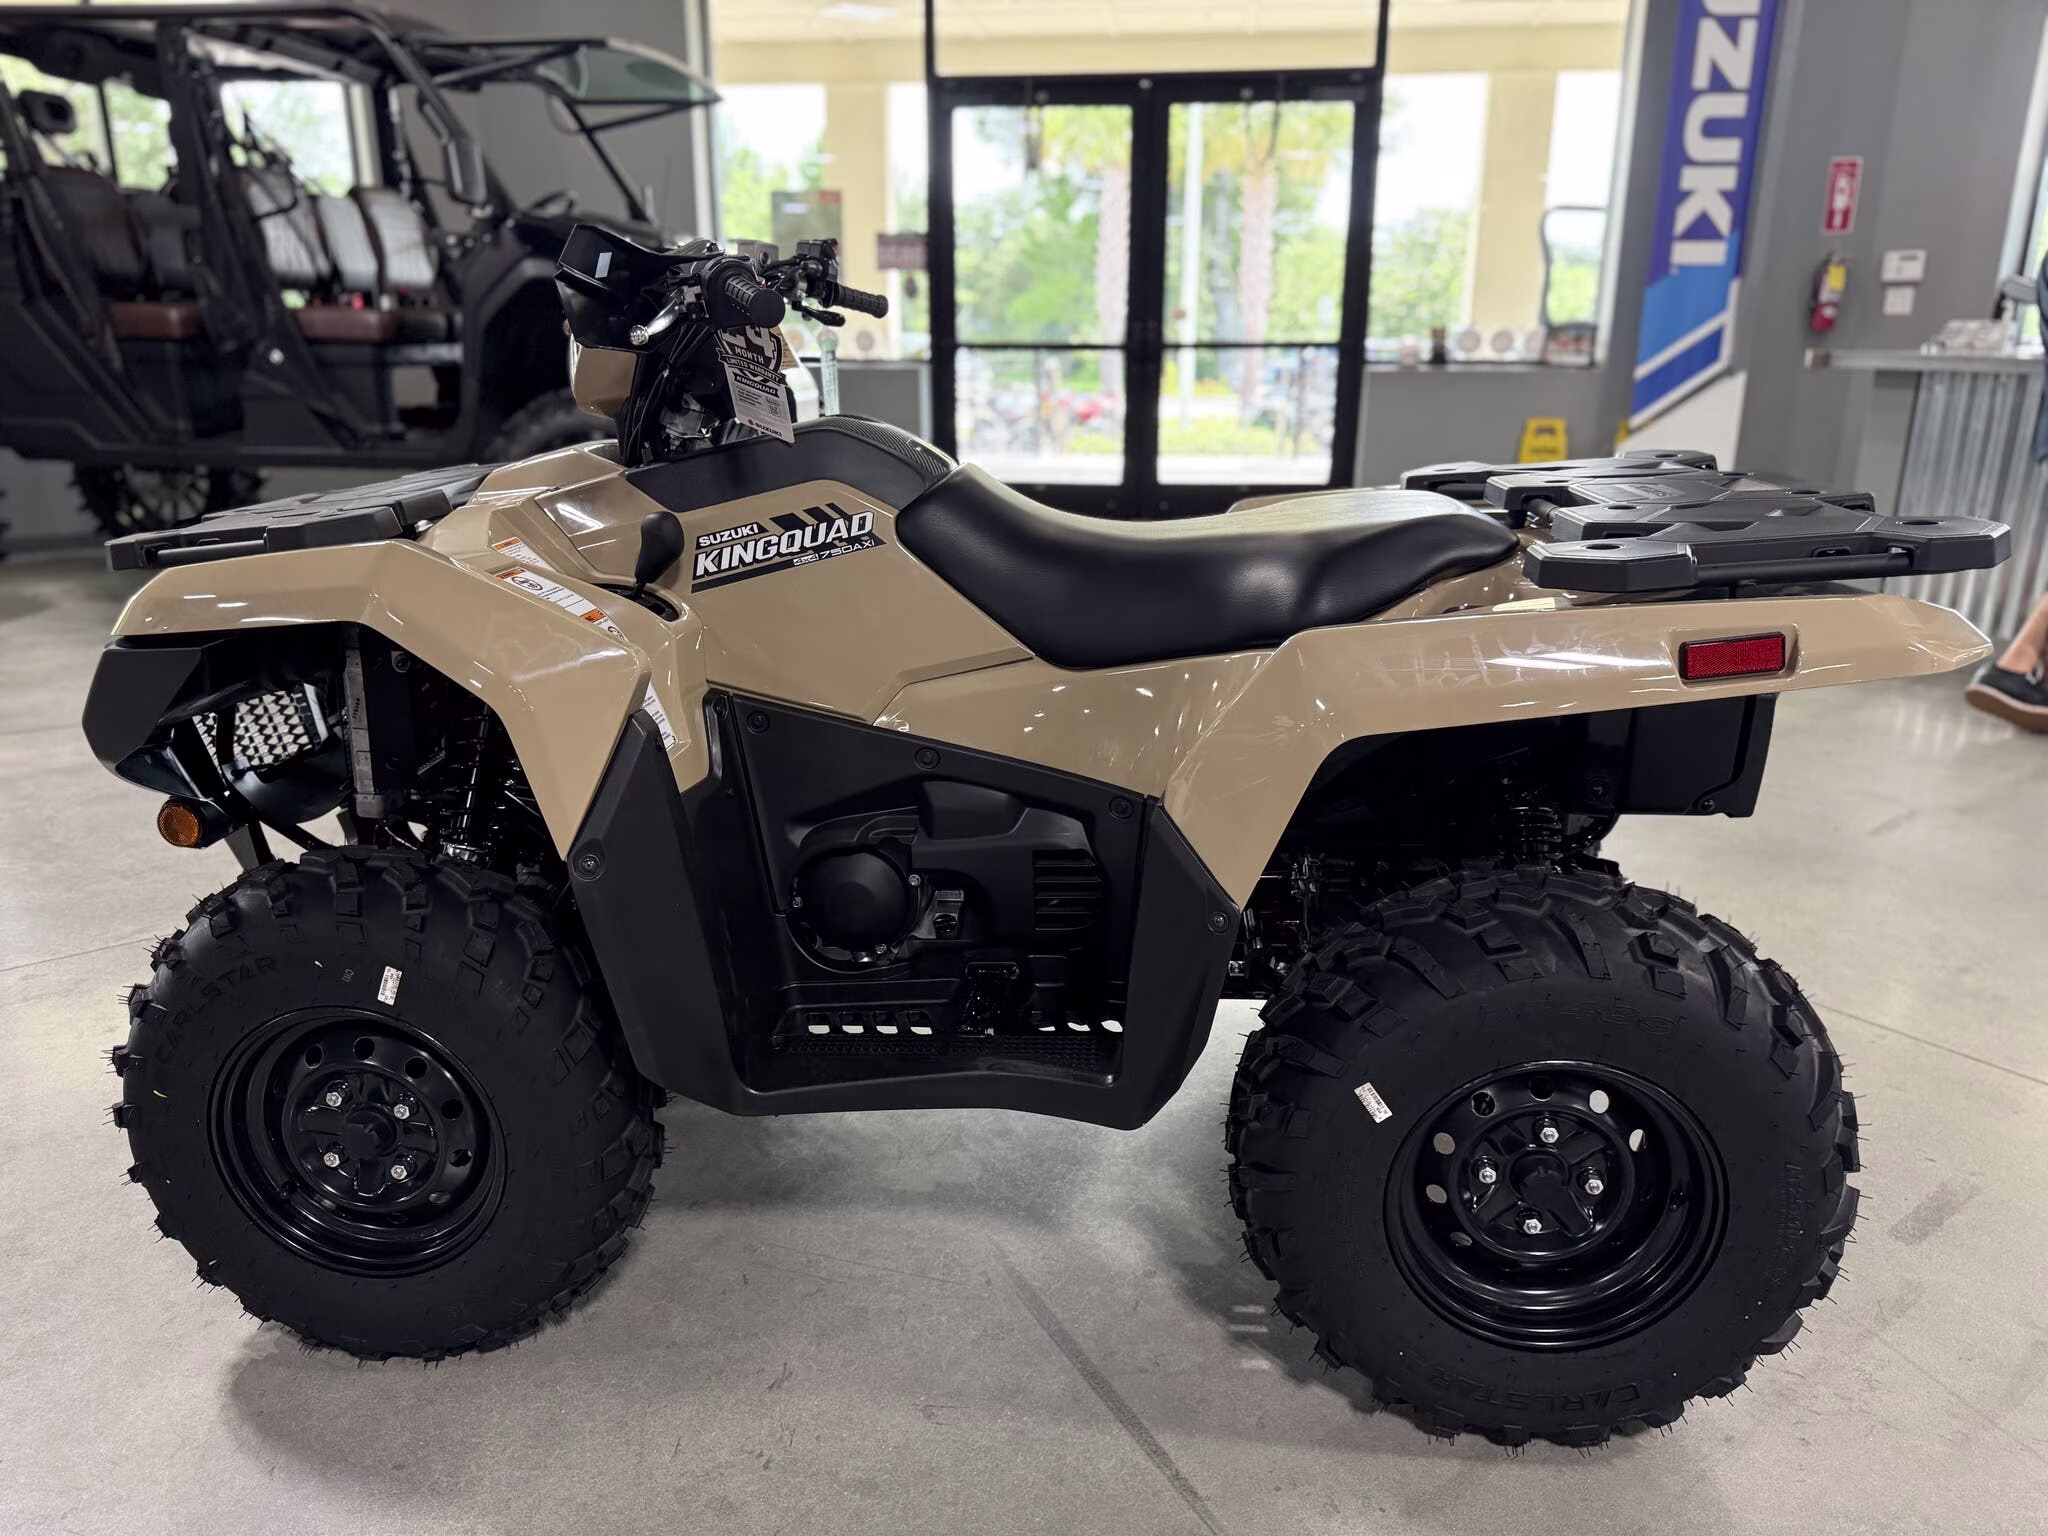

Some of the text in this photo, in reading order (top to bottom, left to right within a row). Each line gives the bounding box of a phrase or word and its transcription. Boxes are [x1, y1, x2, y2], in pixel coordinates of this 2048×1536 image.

[1670, 0, 1761, 265] ZUKI
[735, 346, 764, 364] MONTH
[749, 361, 780, 382] WARRANTY
[754, 422, 783, 437] SUZUKI
[695, 511, 875, 577] KINGQUAD
[699, 523, 759, 547] SUZUKI
